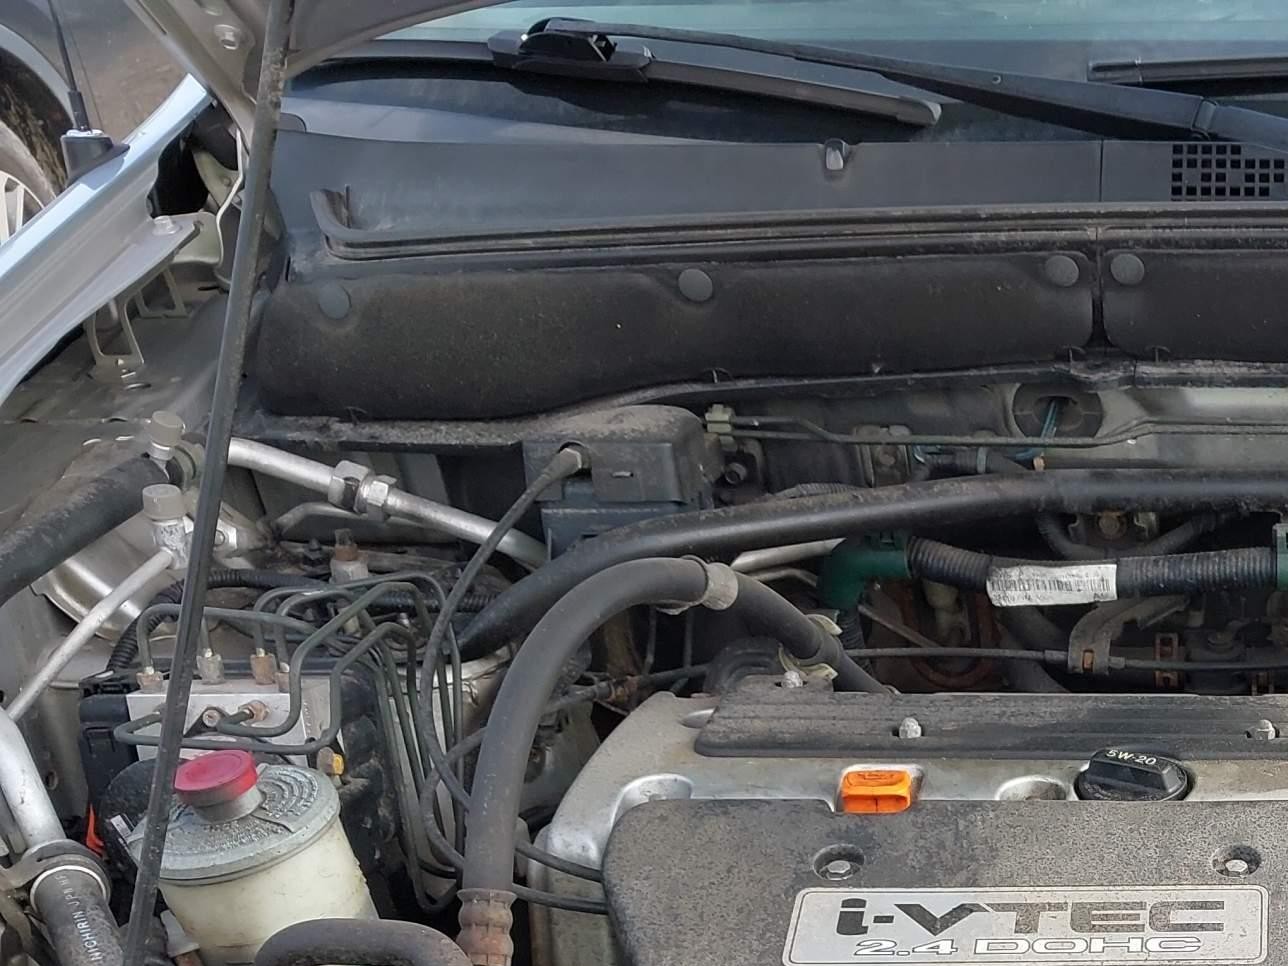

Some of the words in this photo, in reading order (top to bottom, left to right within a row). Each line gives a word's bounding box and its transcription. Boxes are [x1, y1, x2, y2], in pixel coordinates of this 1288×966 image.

[1105, 749, 1157, 765] 5W-20
[835, 897, 1225, 936] i-VTEC
[71, 909, 103, 962] NICHIRIN
[855, 938, 959, 957] 2.4
[973, 935, 1202, 956] DOHC
